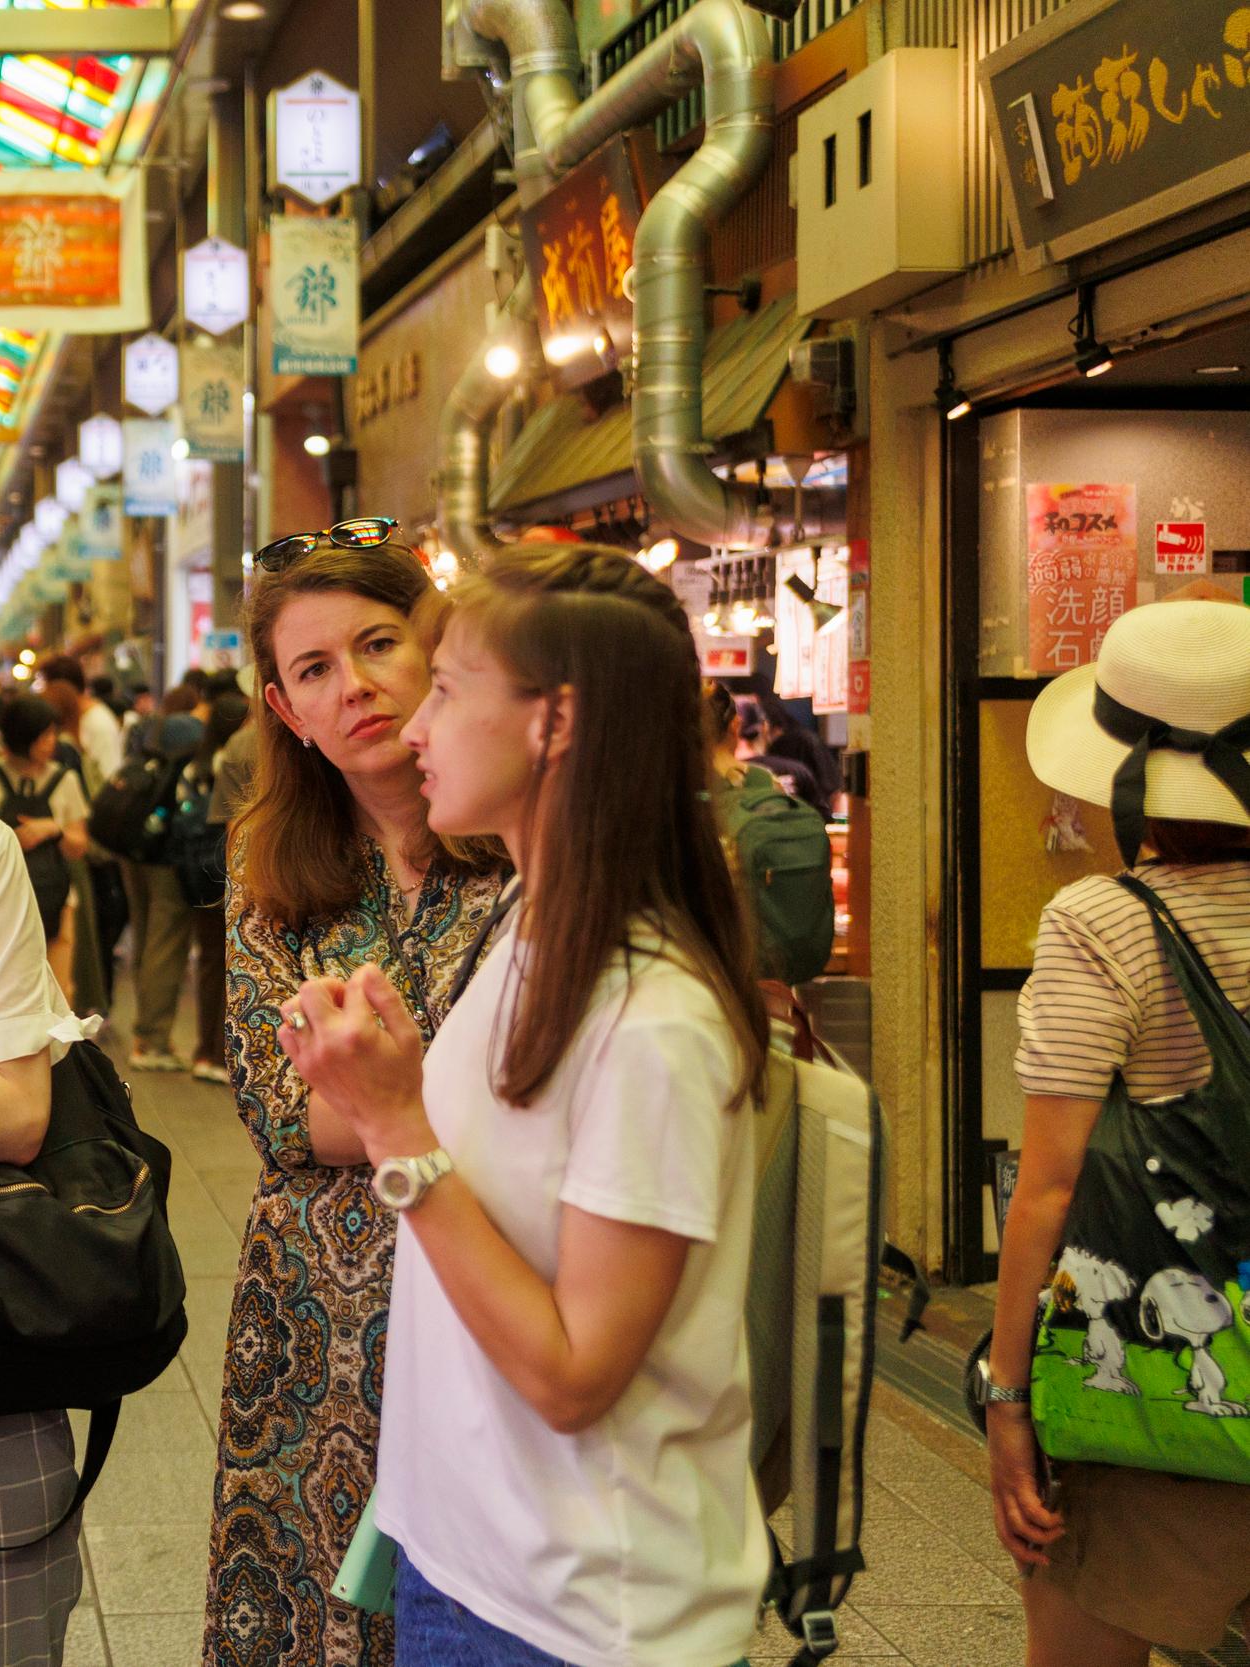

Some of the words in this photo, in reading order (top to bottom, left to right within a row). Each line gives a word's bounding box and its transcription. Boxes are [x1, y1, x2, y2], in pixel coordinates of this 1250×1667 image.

[1044, 511, 1119, 536] 和コスメ
[1046, 586, 1127, 626] 洗顔
